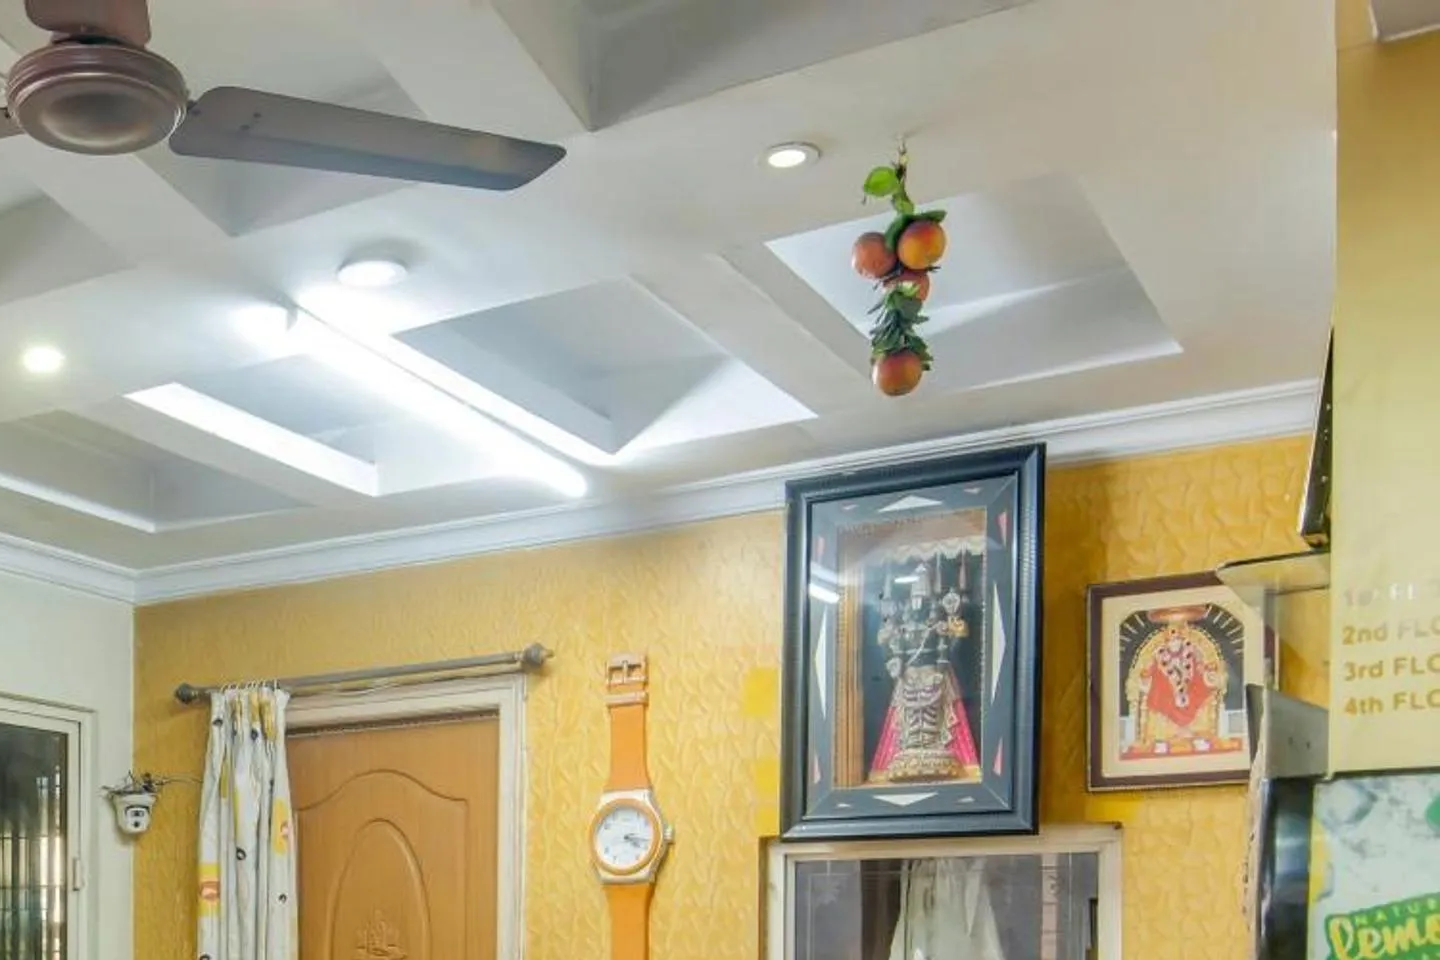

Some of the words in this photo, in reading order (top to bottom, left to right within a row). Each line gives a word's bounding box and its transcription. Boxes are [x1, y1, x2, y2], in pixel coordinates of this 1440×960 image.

[1342, 622, 1389, 646] 2nd
[1344, 659, 1384, 682] 3rd
[1344, 696, 1384, 716] 4th
